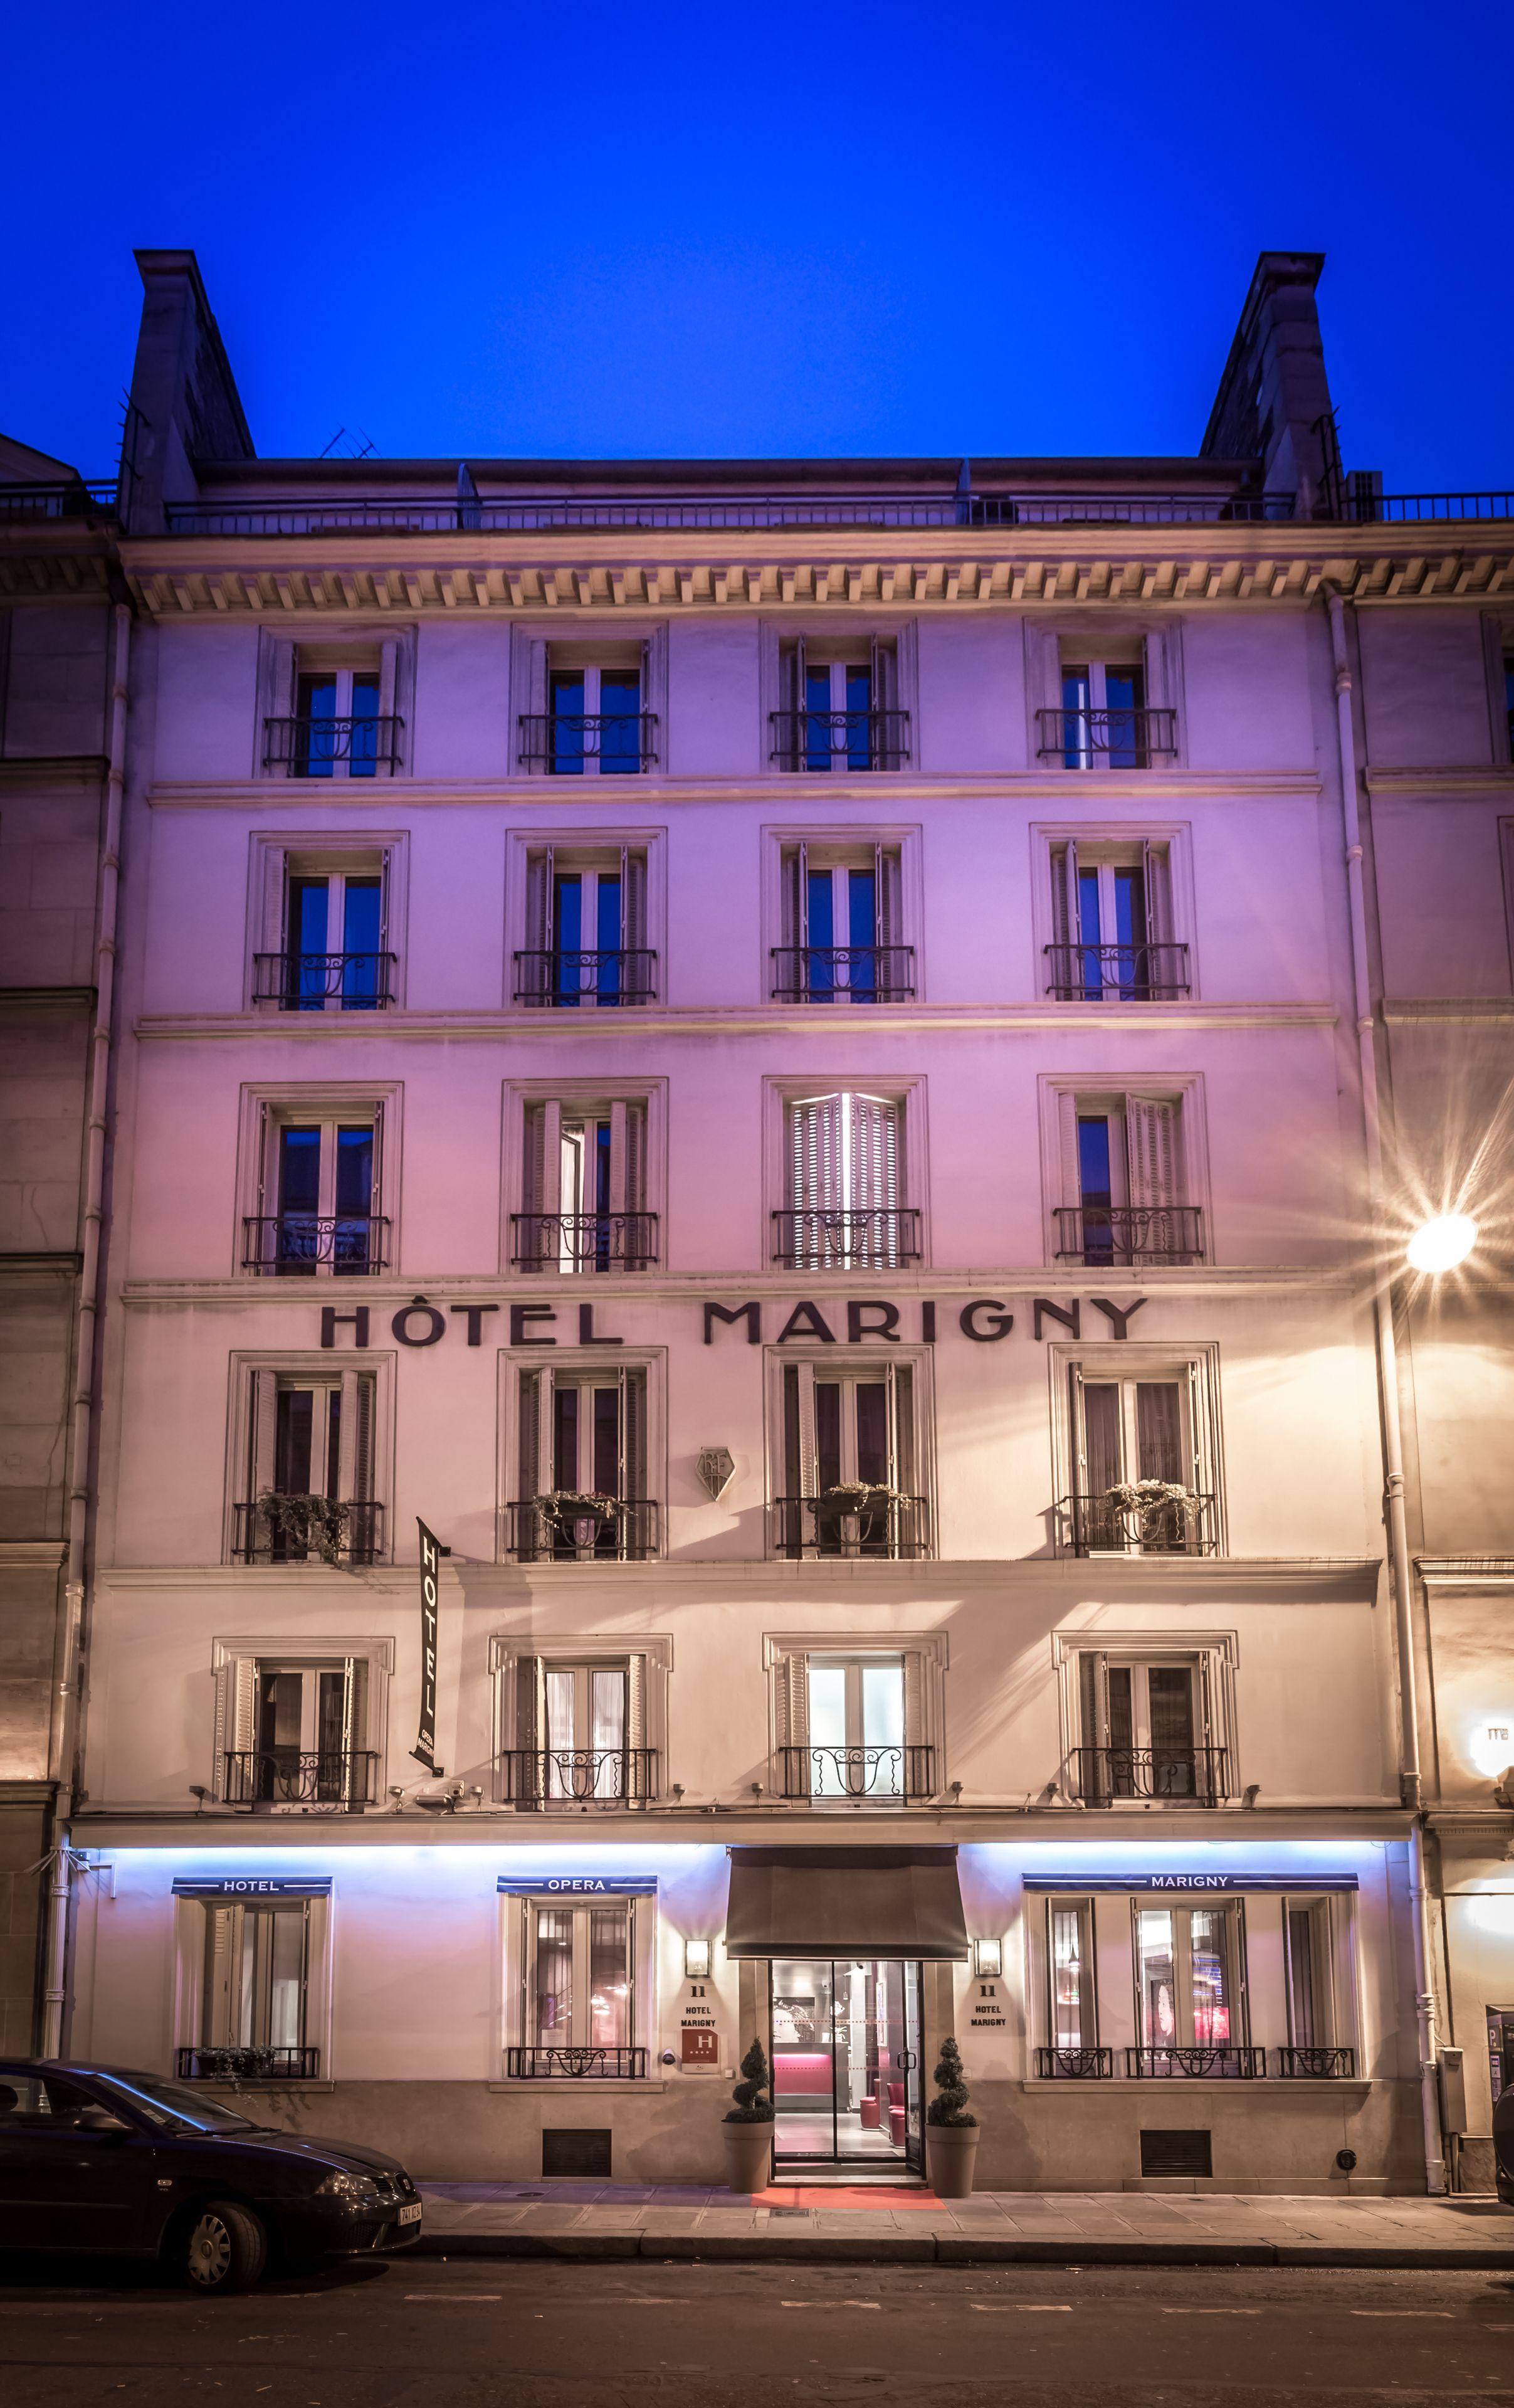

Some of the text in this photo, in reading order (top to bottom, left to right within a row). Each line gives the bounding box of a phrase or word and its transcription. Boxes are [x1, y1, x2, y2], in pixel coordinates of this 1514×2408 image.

[320, 1295, 1148, 1348] HÔTEL MARIGNY
[423, 1535, 436, 1718] HOTEL
[224, 1881, 280, 1891] HOTEL
[548, 1879, 606, 1891] OPERA
[1151, 1876, 1228, 1887] MARIGNY
[690, 1986, 706, 1997] 11
[979, 1985, 996, 1997] 11
[698, 2036, 713, 2048] H
